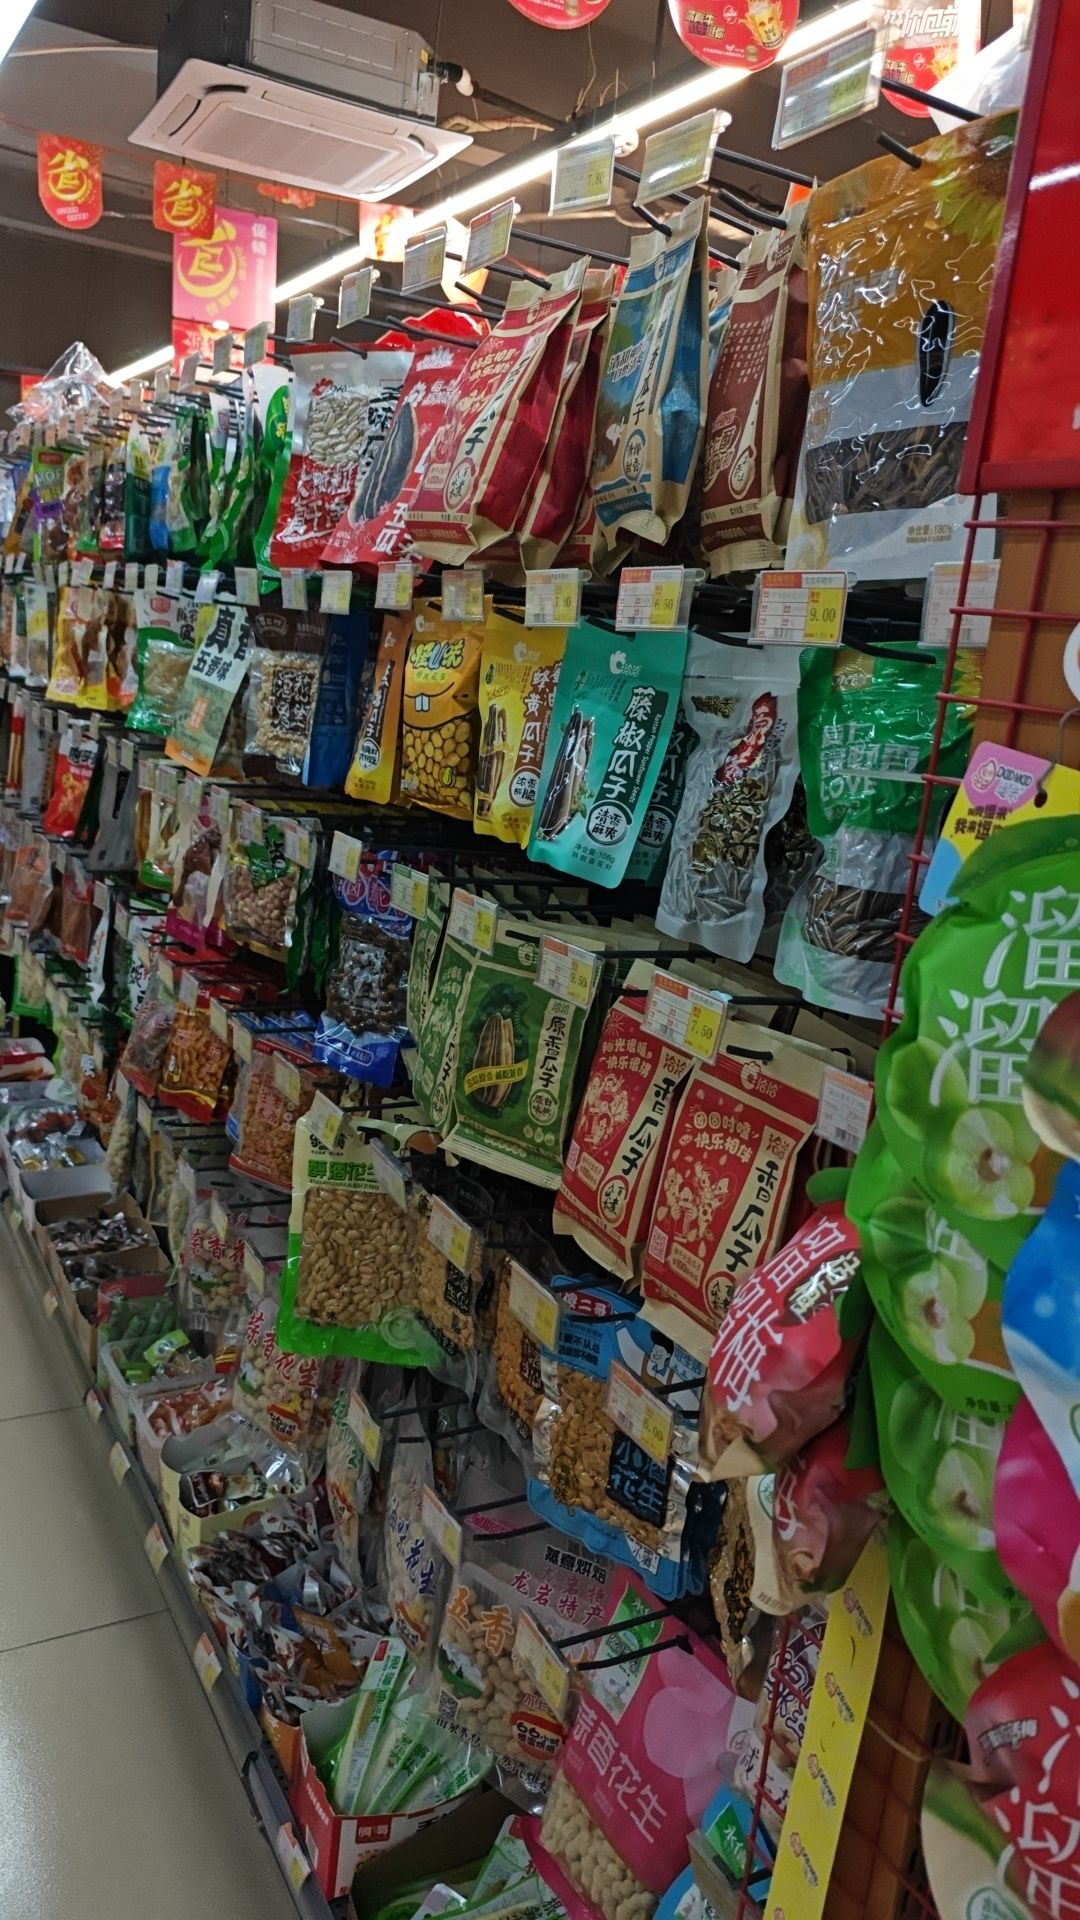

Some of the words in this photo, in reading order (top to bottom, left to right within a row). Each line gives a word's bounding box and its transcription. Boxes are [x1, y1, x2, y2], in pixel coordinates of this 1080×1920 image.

[586, 170, 605, 187] 7.80
[808, 606, 837, 624] 9.00
[192, 650, 232, 682] 五香味
[603, 687, 656, 800] 藤椒瓜子
[595, 808, 623, 827] 清香
[591, 824, 619, 839] 麻爽
[691, 1019, 713, 1040] 7.50
[538, 1015, 567, 1089] 原香瓜子
[665, 1052, 686, 1078] 洽洽
[756, 1076, 779, 1097] 洽洽
[621, 1077, 677, 1176] 香瓜子
[725, 1160, 779, 1272] 香瓜子
[562, 1291, 611, 1317] 傻二哥
[544, 1545, 607, 1584] 蒸煮烘焙
[510, 1569, 605, 1627] 龙岩特产
[446, 1584, 514, 1658] 五香
[516, 1720, 561, 1747] 66小时
